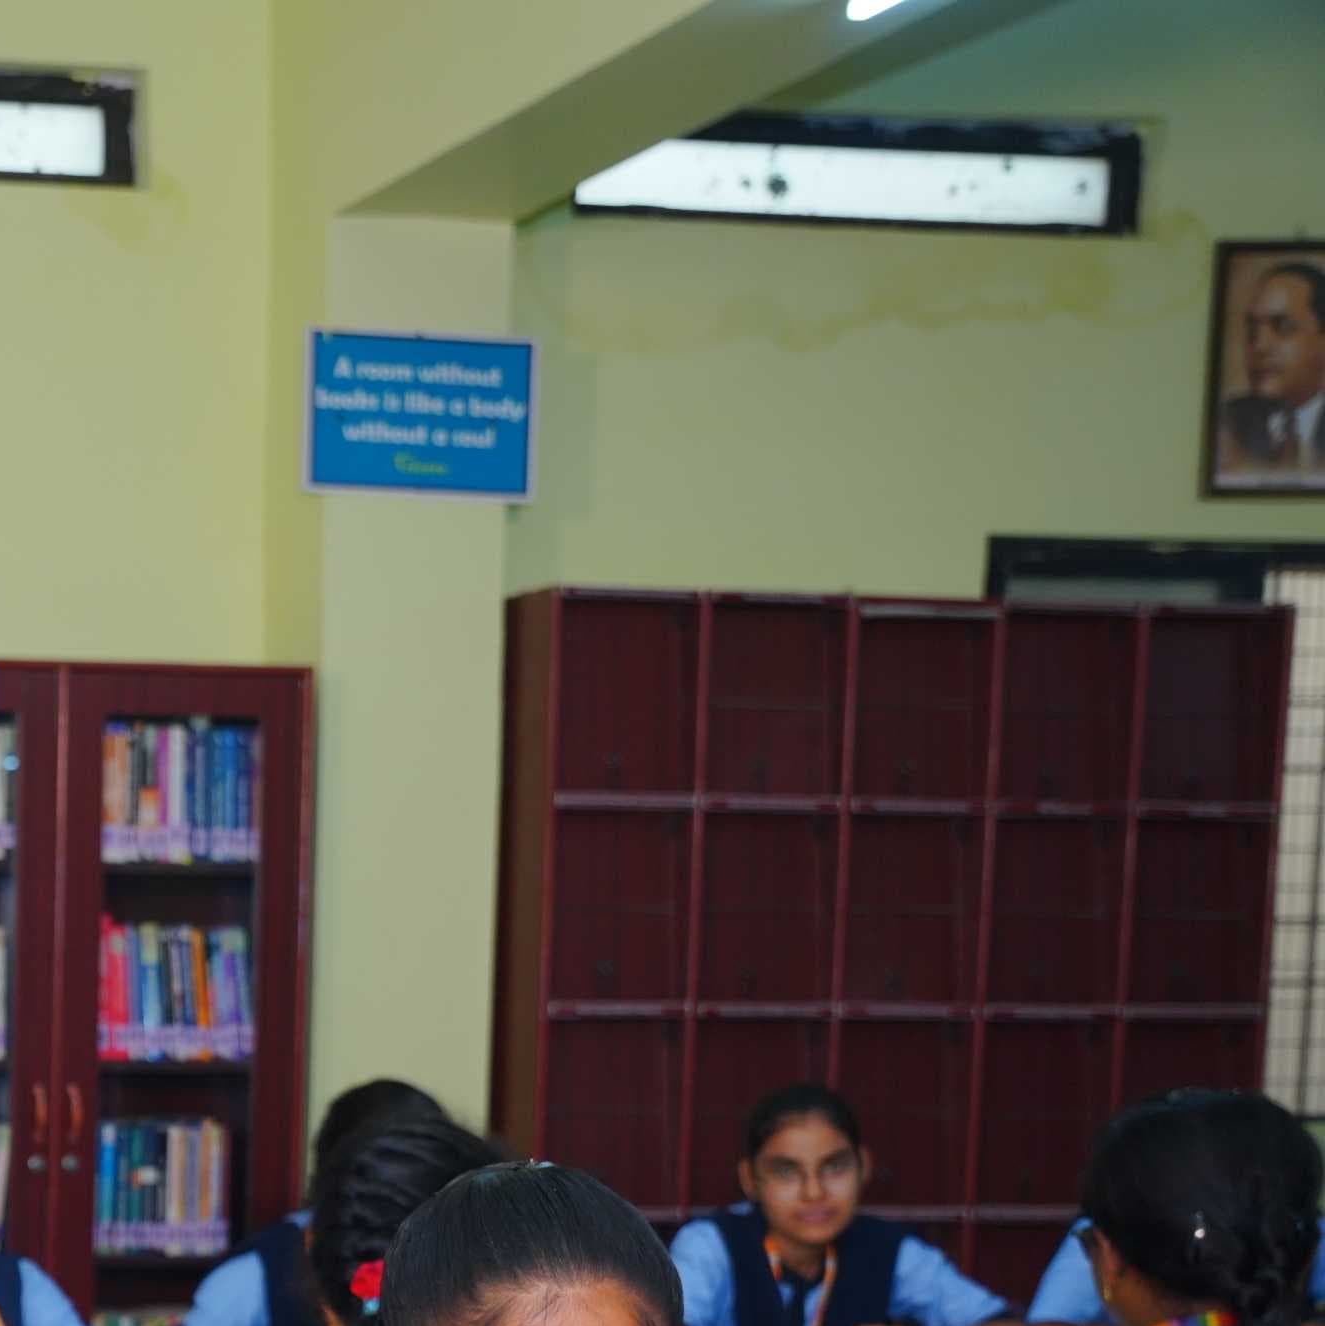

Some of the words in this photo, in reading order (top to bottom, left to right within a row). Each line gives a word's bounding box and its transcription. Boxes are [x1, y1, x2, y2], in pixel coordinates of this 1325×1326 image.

[333, 356, 353, 379] A
[355, 362, 414, 382] room
[417, 363, 503, 388] without
[315, 386, 380, 412] books
[383, 390, 400, 412] is
[404, 390, 446, 415] like
[450, 399, 466, 416] a
[468, 396, 527, 423] body
[342, 421, 429, 446] without
[432, 430, 448, 447] a
